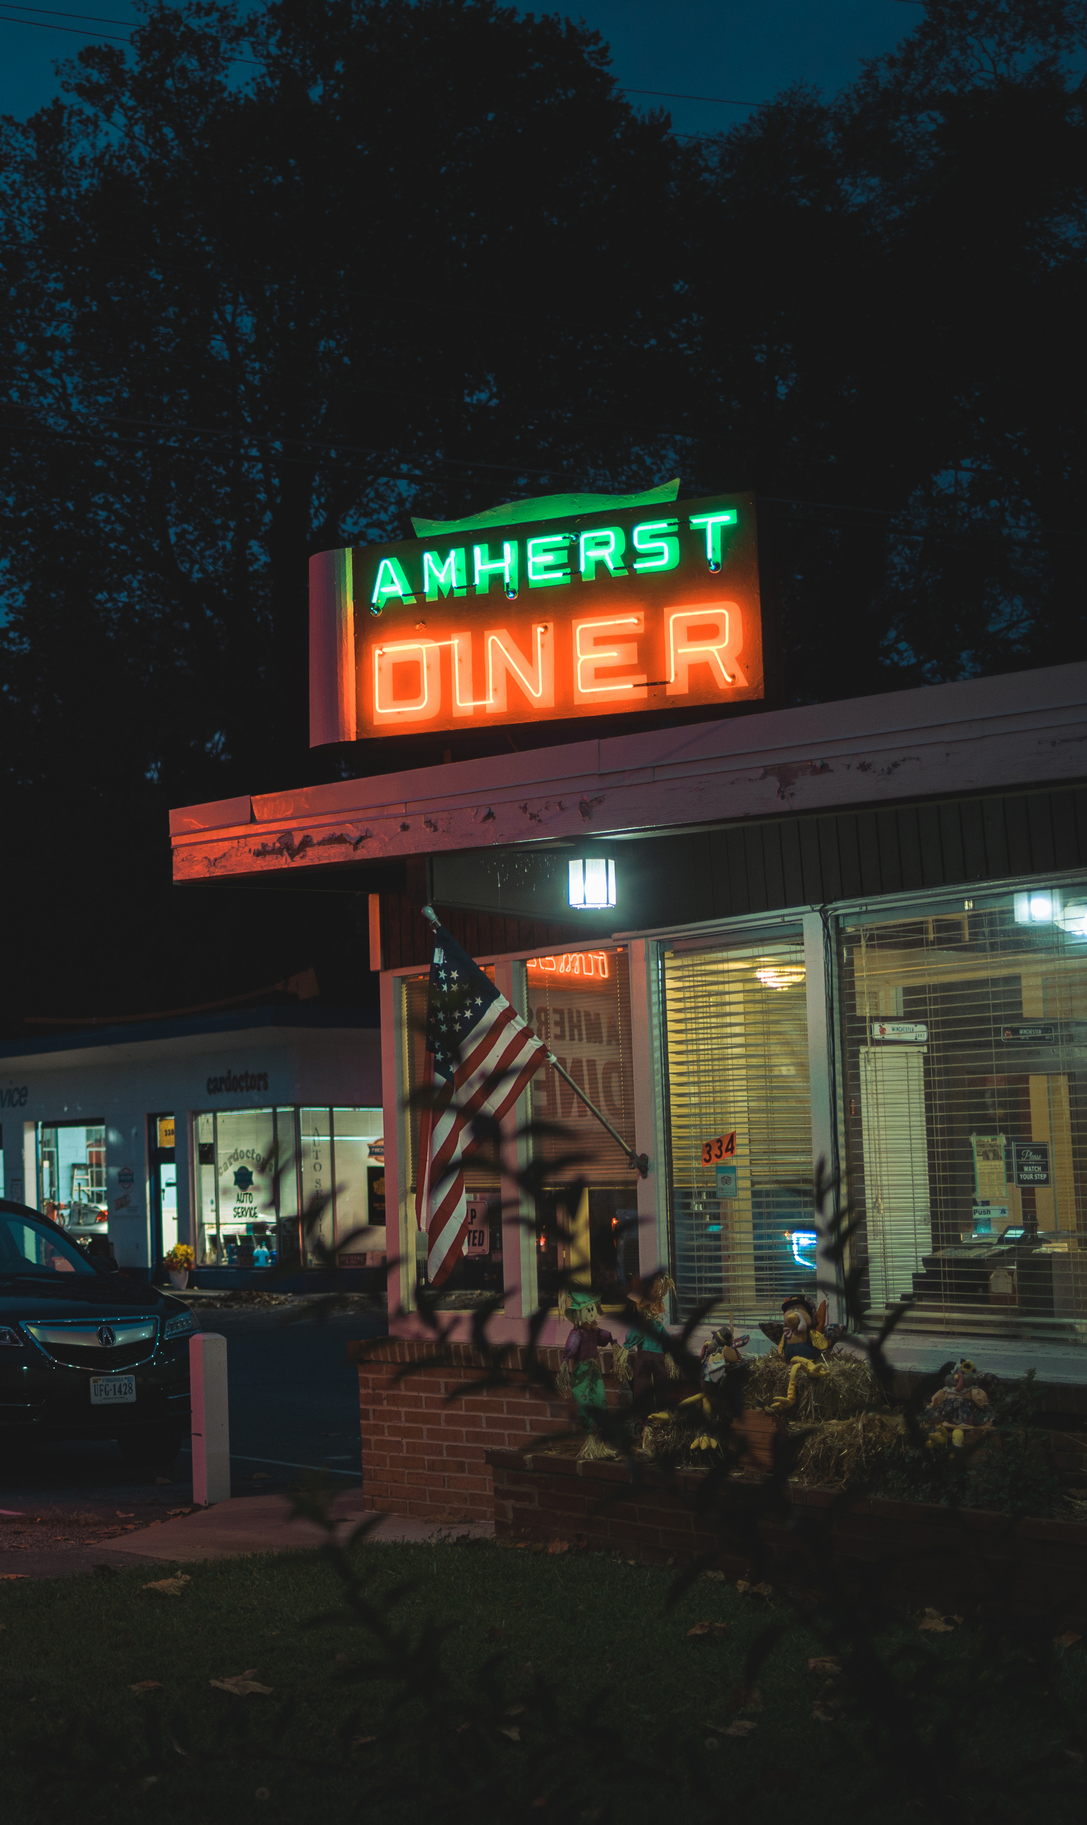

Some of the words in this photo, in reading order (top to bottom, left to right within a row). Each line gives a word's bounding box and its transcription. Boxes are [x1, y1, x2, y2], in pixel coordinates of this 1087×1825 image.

[370, 508, 738, 608] AMHERST
[371, 601, 749, 726] DINER
[206, 1069, 269, 1095] cardoctors
[703, 1133, 735, 1163] 334
[236, 1192, 254, 1204] AUTO
[232, 1206, 259, 1218] SERVICE
[973, 1208, 991, 1216] Push
